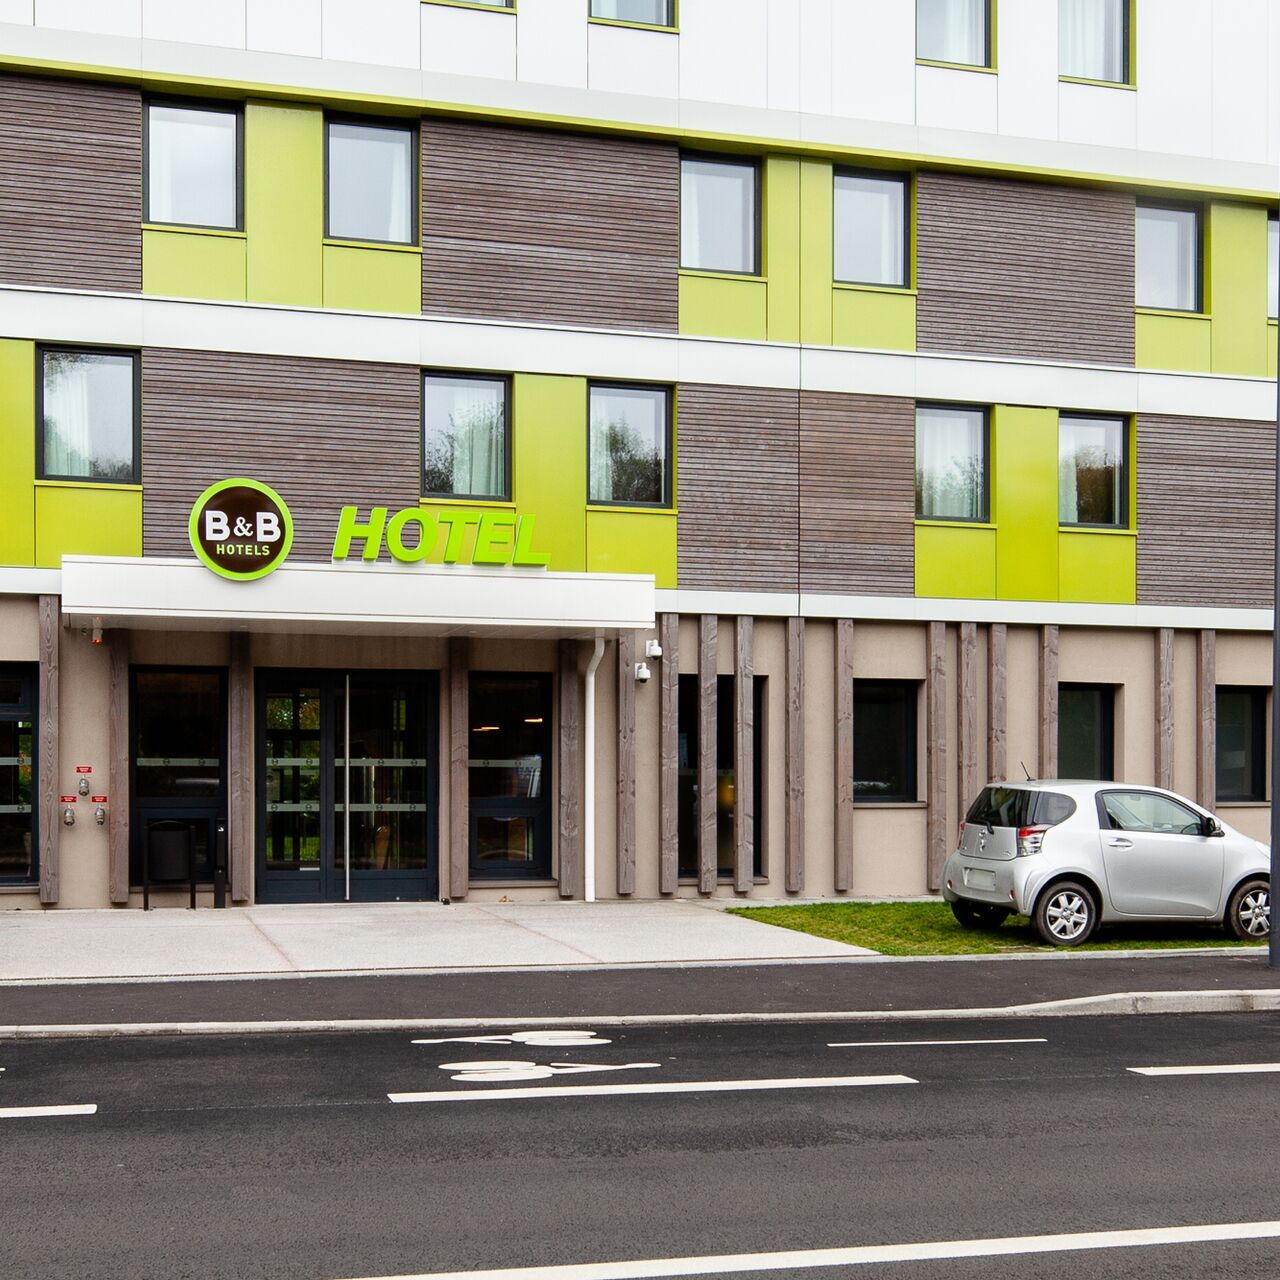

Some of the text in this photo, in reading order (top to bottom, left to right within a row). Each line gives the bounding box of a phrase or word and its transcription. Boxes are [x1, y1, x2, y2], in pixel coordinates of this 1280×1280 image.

[204, 510, 282, 543] B&B
[331, 506, 552, 566] HOTEL
[215, 543, 271, 556] HOTELS
